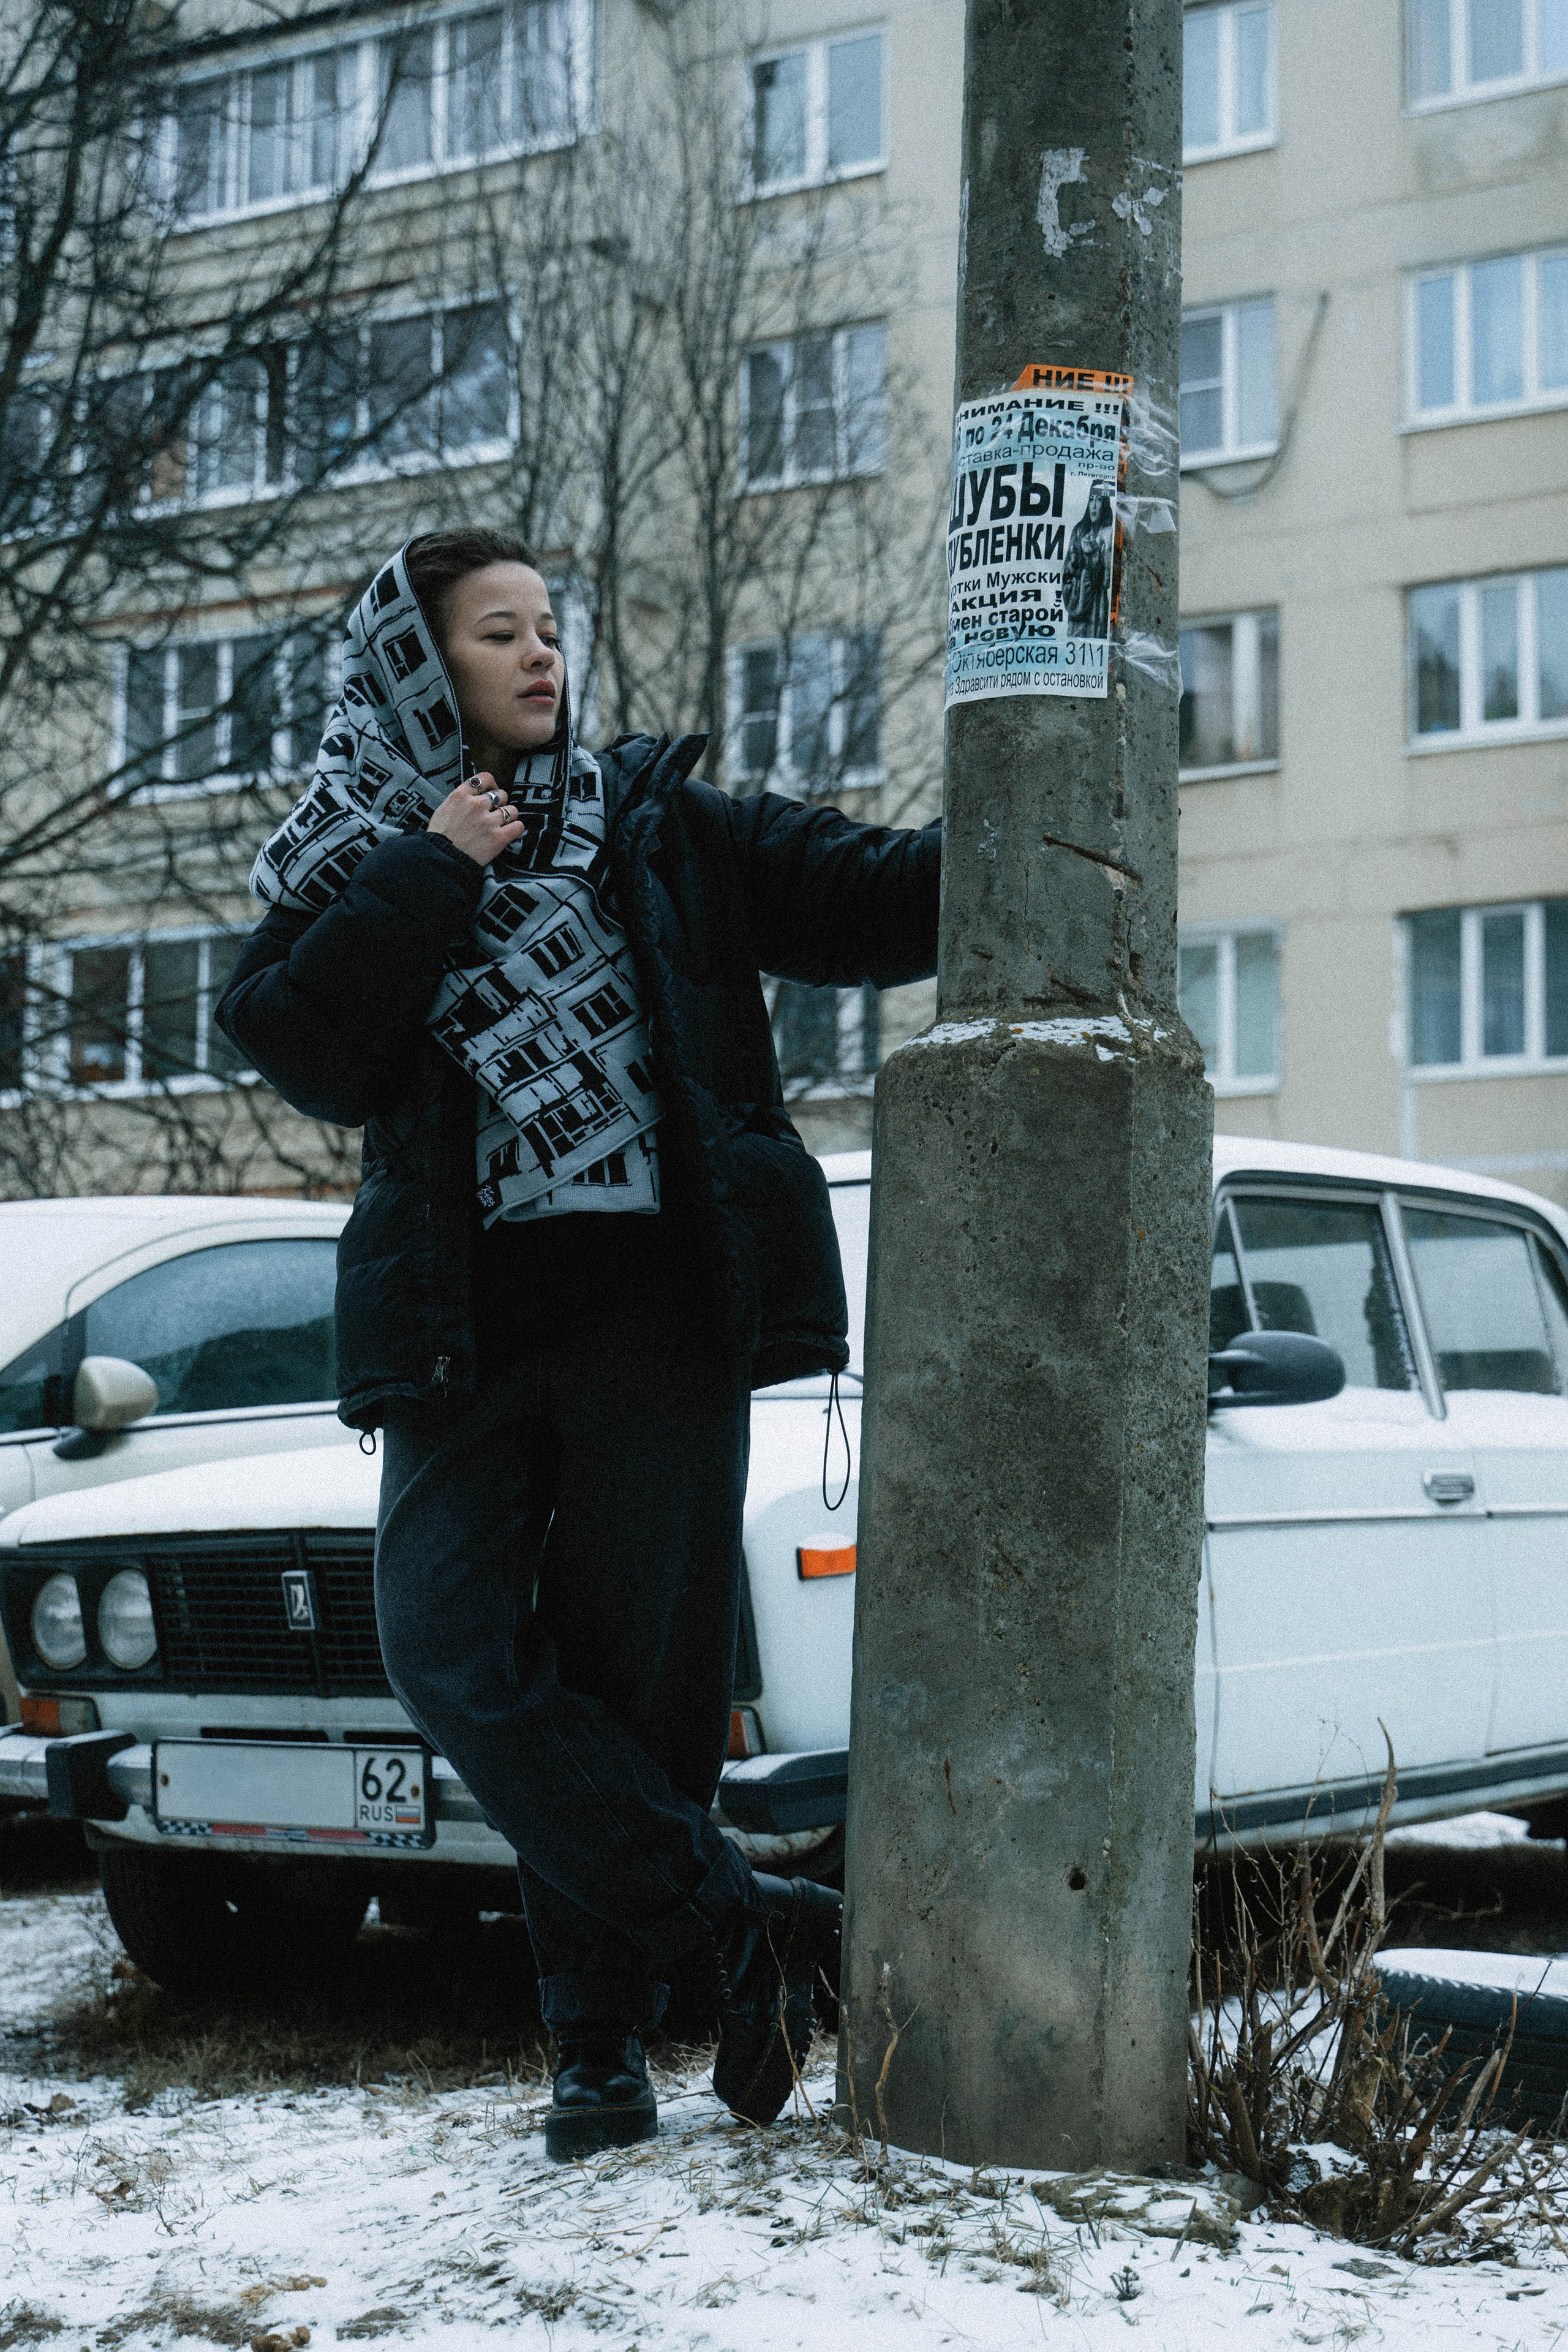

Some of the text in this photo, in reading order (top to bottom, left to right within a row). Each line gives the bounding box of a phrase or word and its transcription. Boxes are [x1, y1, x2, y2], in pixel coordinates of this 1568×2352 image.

[1032, 369, 1095, 391] НИЕ
[1095, 403, 1120, 415] !!!
[965, 426, 985, 448] по
[1017, 412, 1116, 448] Декабря
[1078, 471, 1116, 480] Пятигорск
[986, 571, 1073, 590] Мужские
[951, 589, 1063, 614] АКЦИЯ !
[988, 603, 1063, 629] старой
[964, 624, 1056, 645] новую
[1065, 641, 1104, 668] 31\1
[955, 674, 999, 696] Здравсити
[1000, 671, 1031, 690] рядом
[1035, 673, 1040, 685] с
[1043, 671, 1103, 690] остановкой
[360, 1757, 407, 1803] 62
[359, 1805, 394, 1822] RUS
